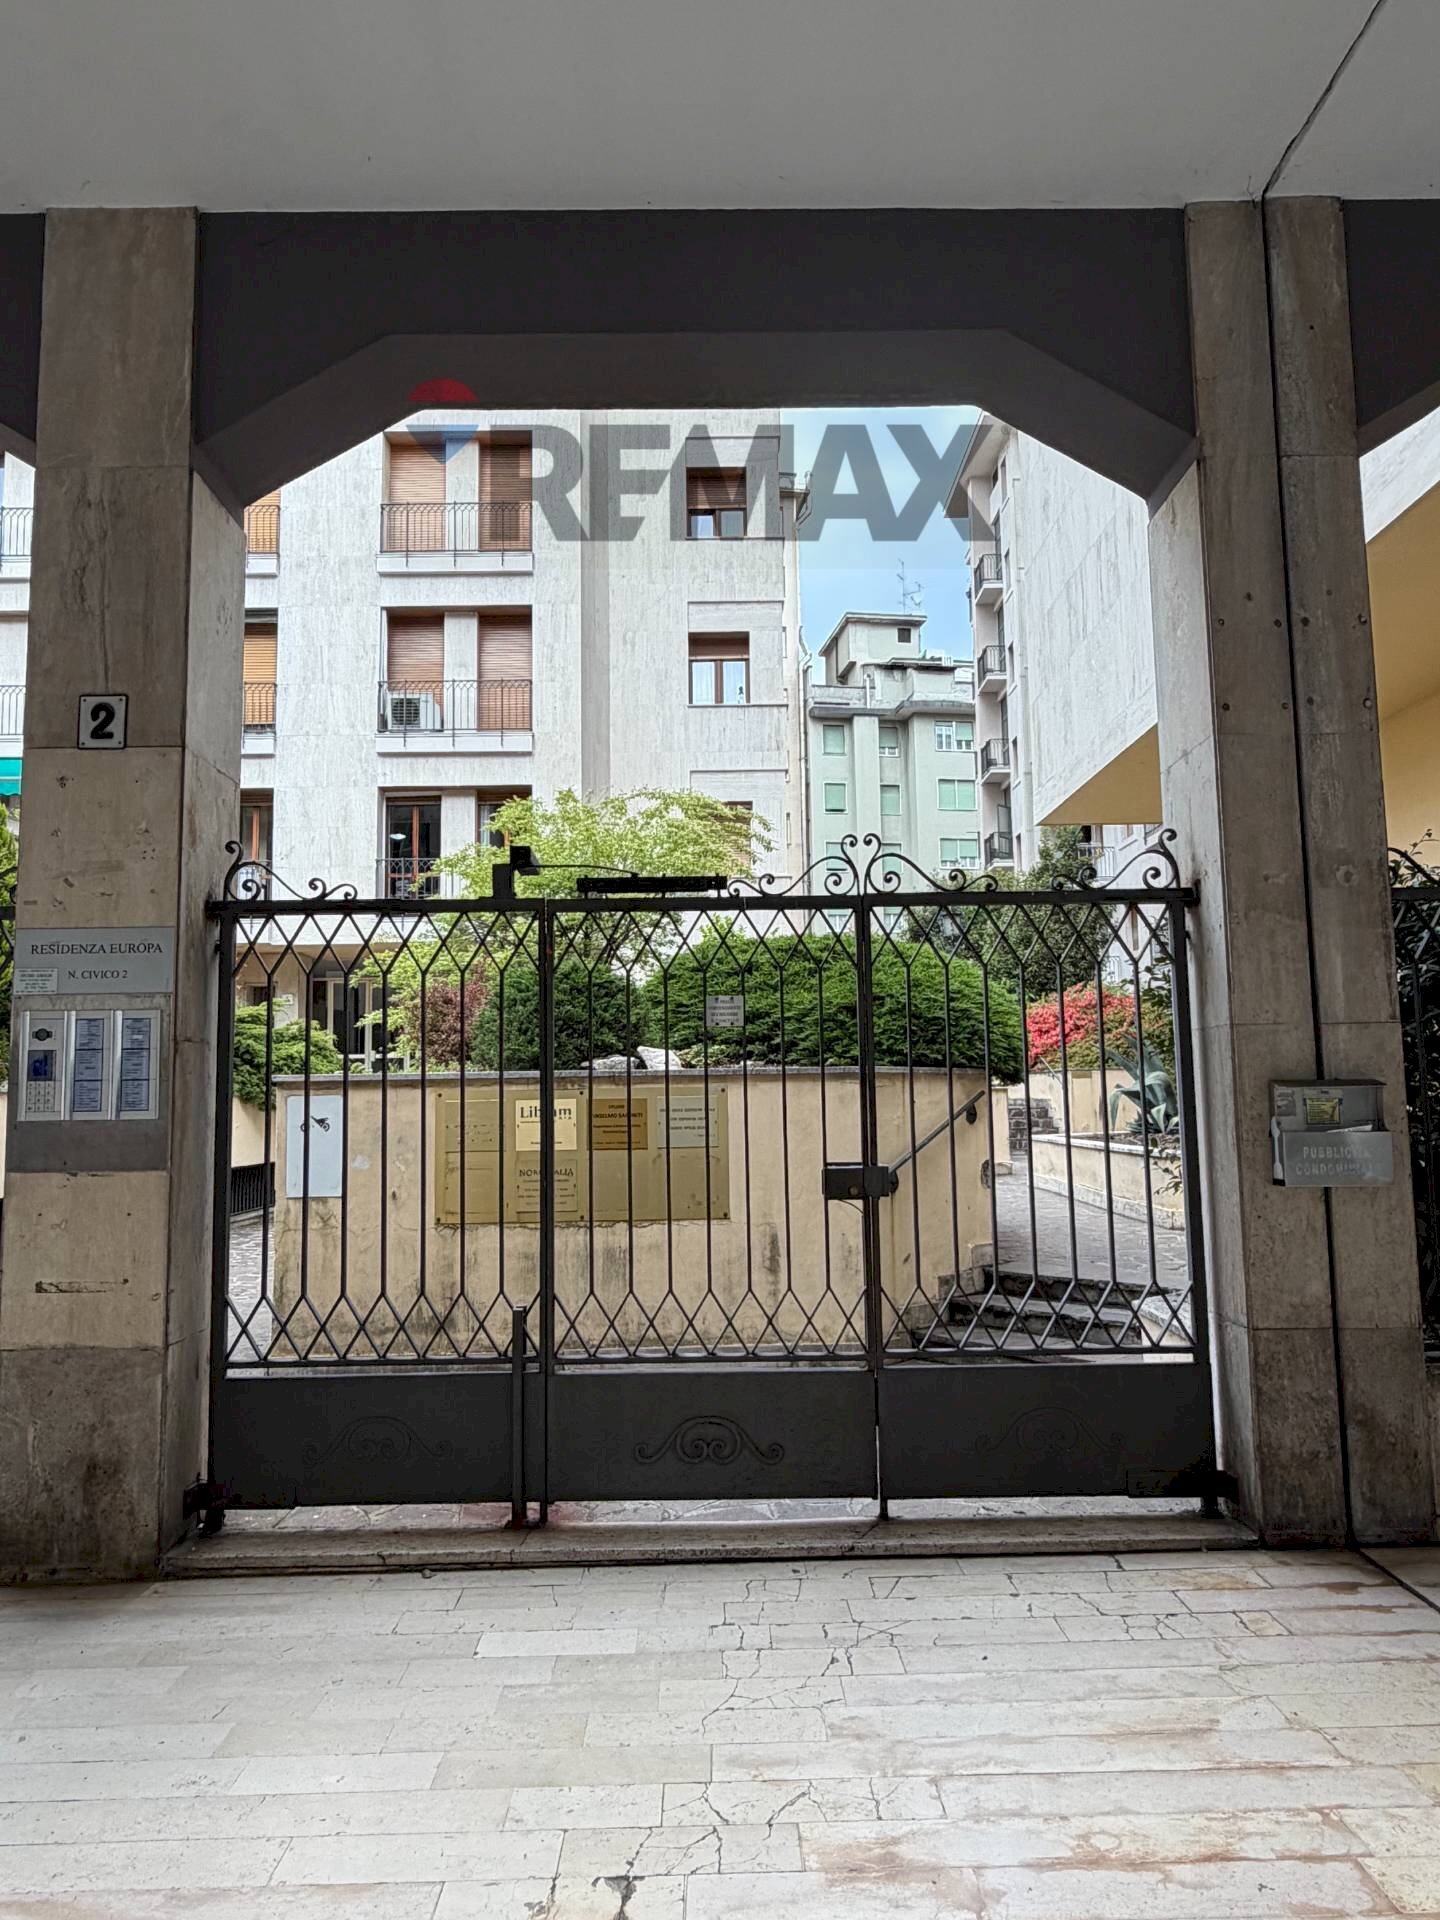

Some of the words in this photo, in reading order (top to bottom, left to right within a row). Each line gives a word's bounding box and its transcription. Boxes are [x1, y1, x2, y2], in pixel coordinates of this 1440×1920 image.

[90, 702, 115, 739] 2
[31, 942, 107, 955] RESIDENZA
[109, 941, 163, 954] EUROPA
[67, 969, 79, 979] N.
[81, 969, 120, 979] CIVICO
[121, 969, 128, 979] 2
